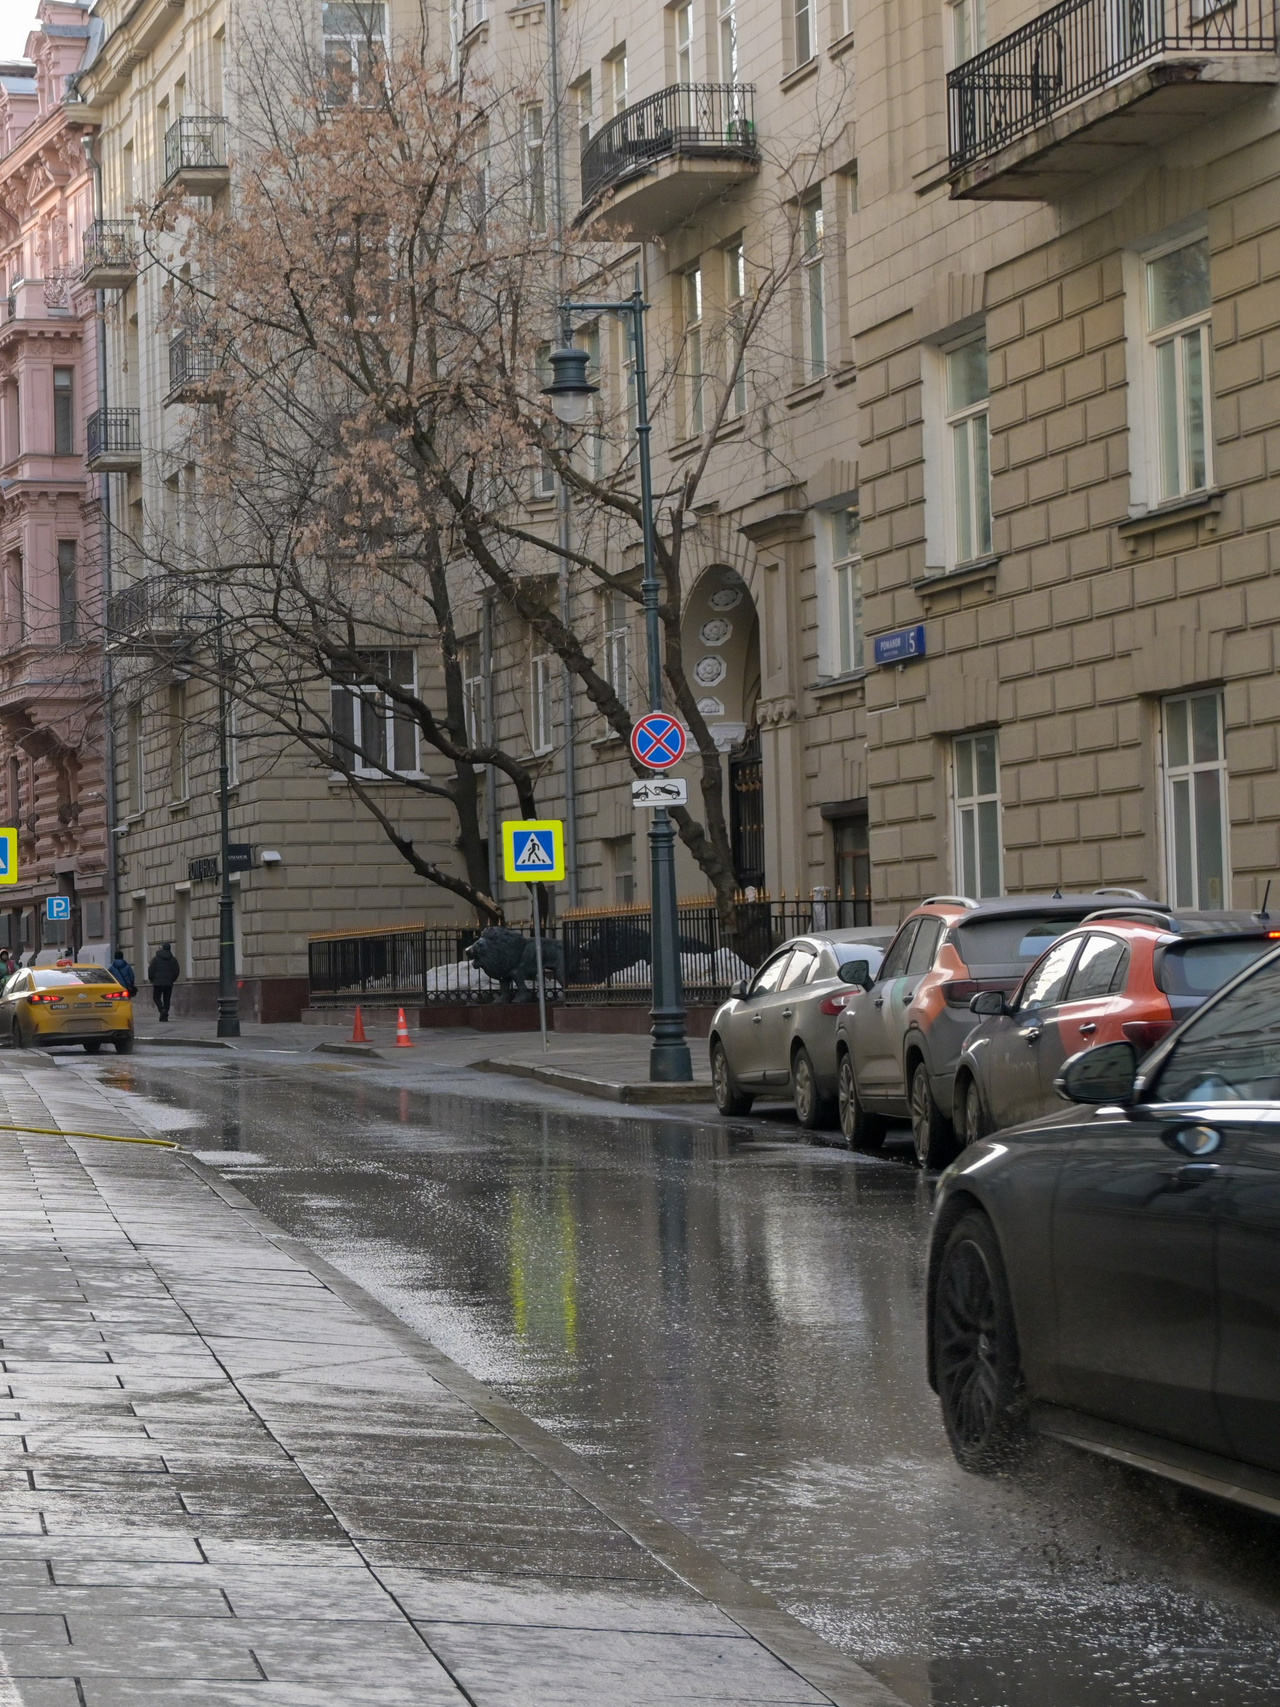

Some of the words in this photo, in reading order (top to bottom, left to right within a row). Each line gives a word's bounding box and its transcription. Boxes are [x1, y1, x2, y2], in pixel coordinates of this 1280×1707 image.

[880, 638, 901, 651] РОМАНОВ
[909, 632, 915, 653] 5
[53, 900, 65, 917] P
